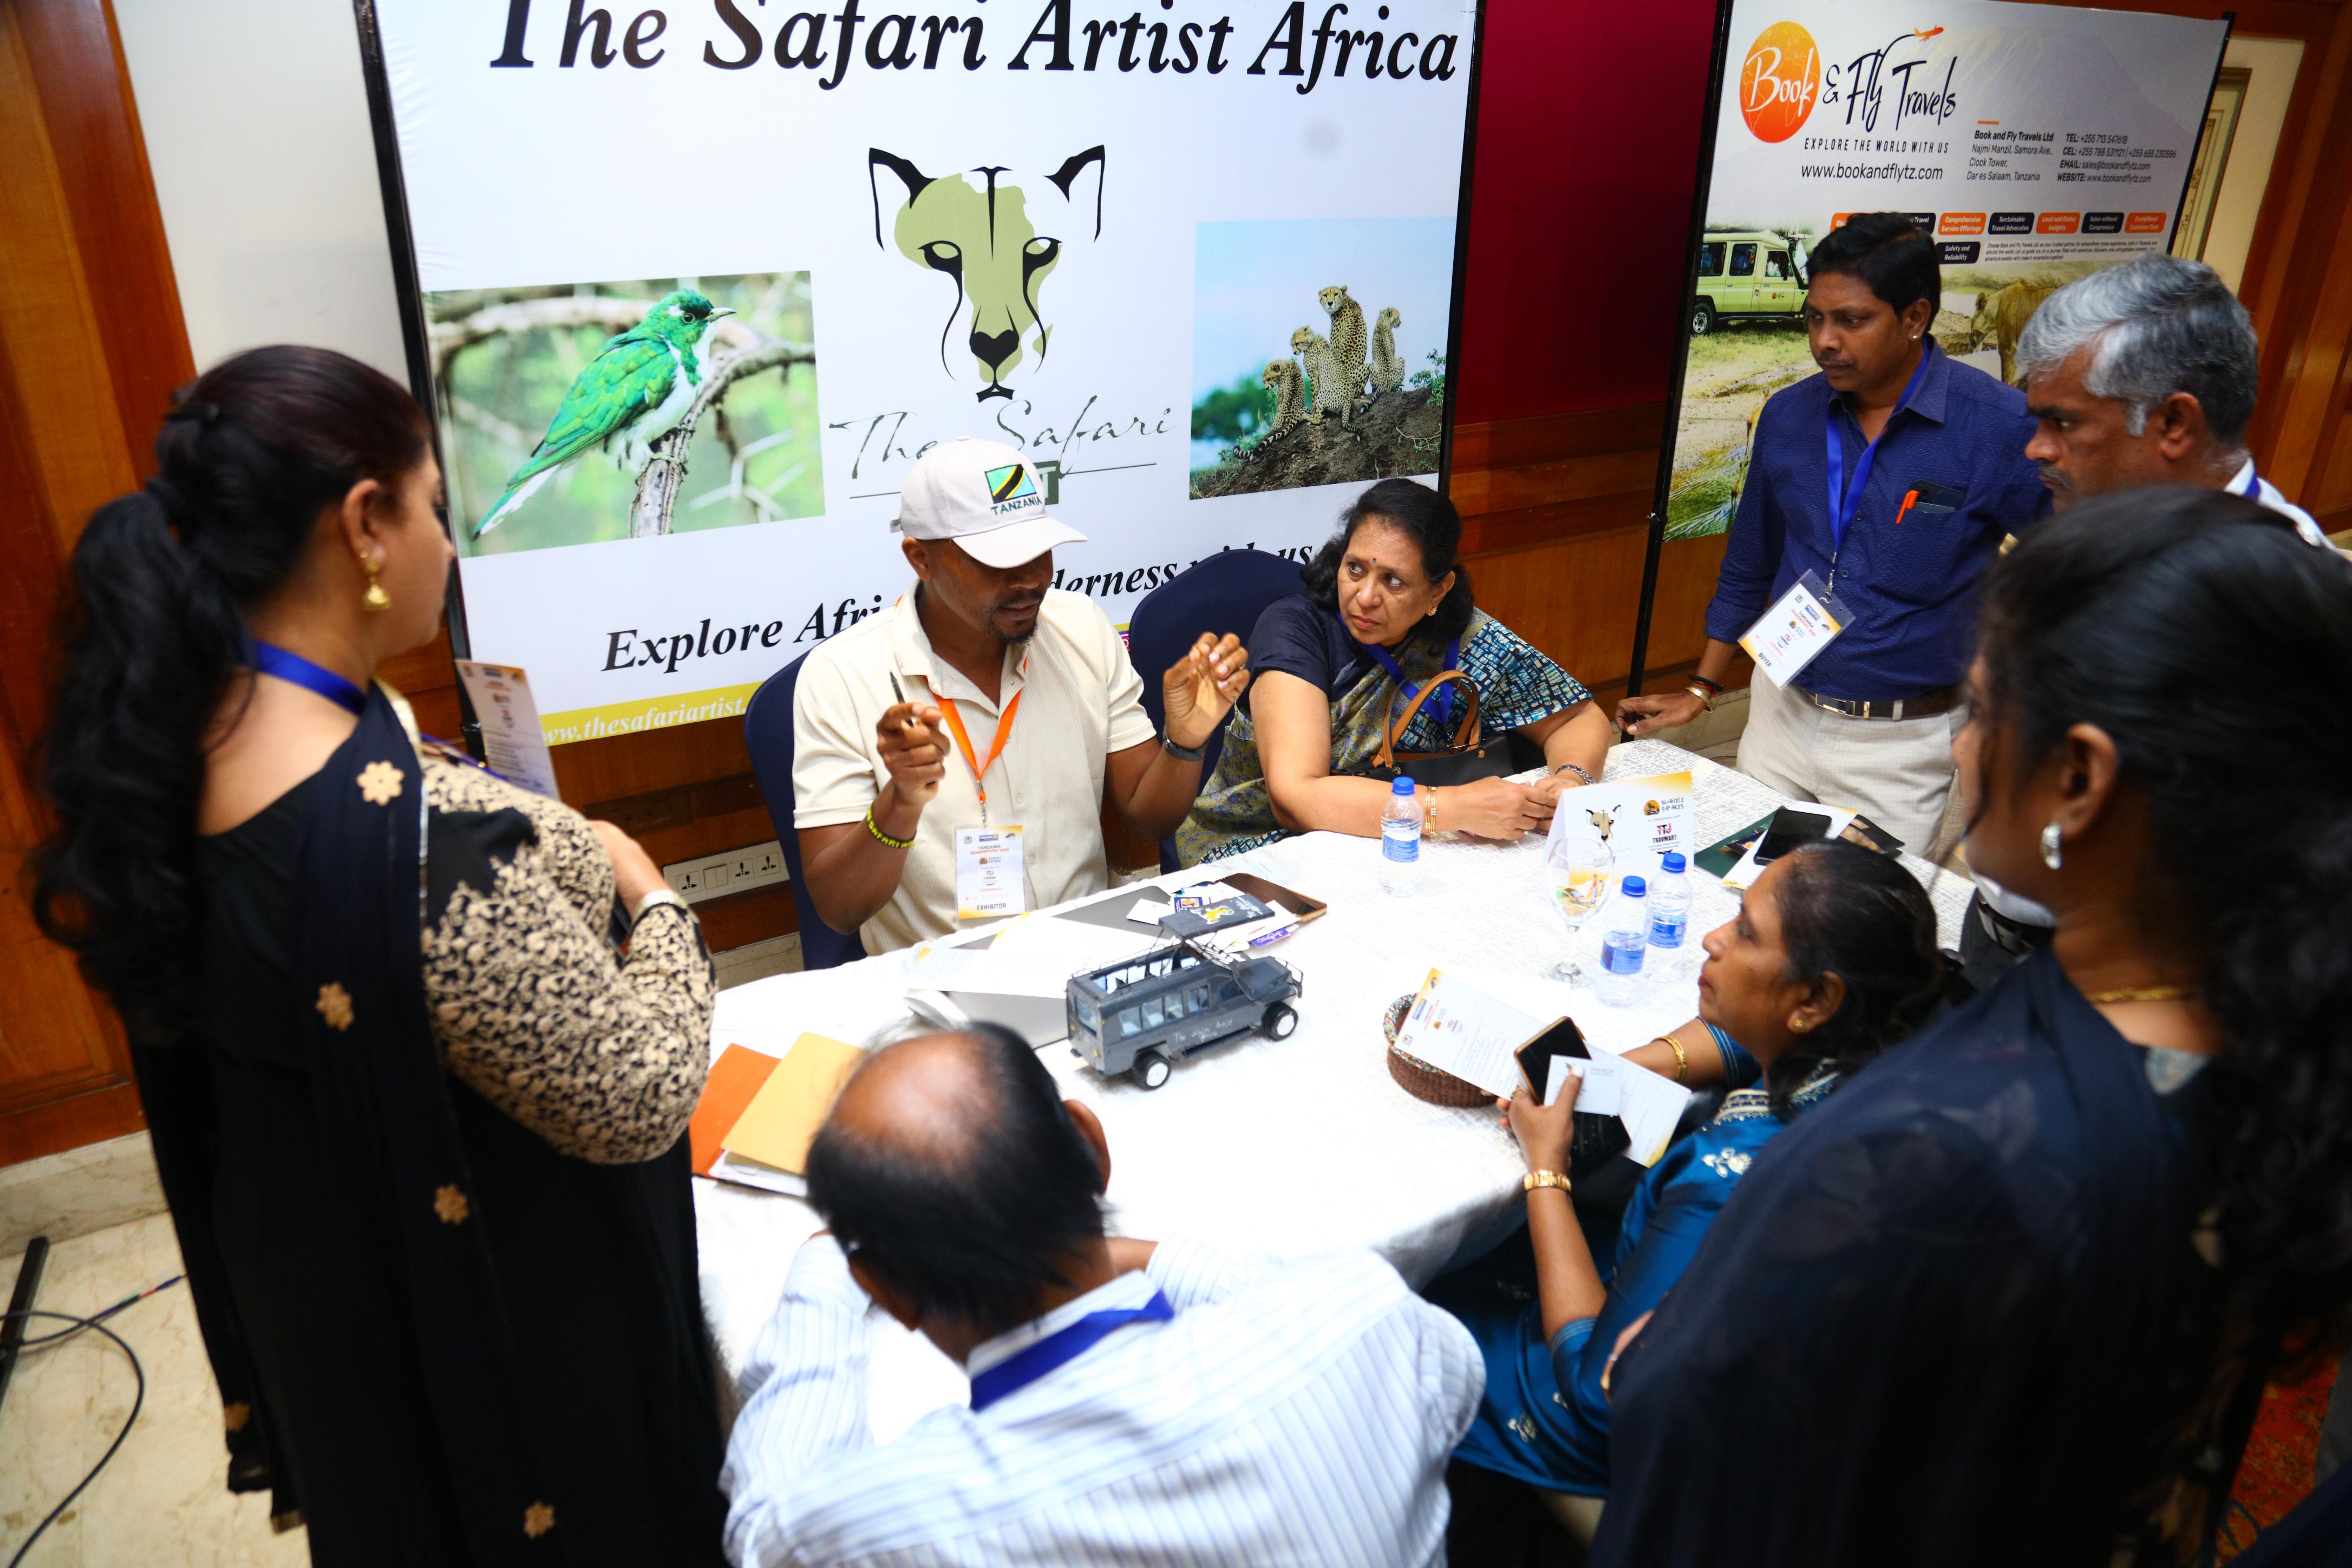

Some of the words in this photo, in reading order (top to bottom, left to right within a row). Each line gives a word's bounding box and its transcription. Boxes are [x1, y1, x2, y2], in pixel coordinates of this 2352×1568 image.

[703, 0, 987, 90] Safari
[1007, 0, 1234, 74] Artist
[1246, 1, 1458, 95] Africa
[1745, 47, 1814, 117] Book
[1822, 64, 1840, 103] &
[1846, 49, 1884, 132] Fly
[1892, 56, 1957, 130] Travels
[1975, 130, 1991, 140] Book
[1992, 132, 2005, 140] and
[2007, 132, 2017, 142] Fly
[2018, 132, 2041, 141] Travels
[2043, 133, 2054, 141] Ltd
[2066, 134, 2079, 142] TEL:
[2081, 134, 2095, 143] +255
[1805, 138, 1849, 151] EXPLORE
[1854, 139, 1870, 151] THE
[1877, 140, 1906, 152] WORLD
[1912, 141, 1933, 153] WITH
[1938, 142, 1949, 153] US
[1971, 145, 1990, 154] Najmi
[1991, 145, 2012, 154] Manzil,
[2014, 145, 2037, 154] Samora
[2063, 147, 2076, 155] CEL:
[2079, 148, 2092, 156] +255
[1969, 158, 1987, 167] Clock
[1989, 158, 2007, 167] Tower,
[2060, 160, 2080, 168] EMAIL:
[1802, 162, 1943, 182] www.bookandflytz.com
[1967, 171, 1978, 180] Dar
[1988, 172, 2011, 181] Salaam,
[2014, 172, 2040, 181] Tanzania
[2057, 173, 2086, 181] WEBSITE:
[2087, 174, 2151, 184] www.bookandflytz.com
[829, 410, 938, 479] The
[996, 395, 1174, 480] Safari
[990, 496, 1042, 516] TANZANIA
[600, 618, 783, 674] Explore
[1048, 563, 1177, 597] derness
[1758, 652, 1772, 667] BUYER
[542, 697, 747, 743] ww.thesafariartist.
[1656, 822, 1672, 835] TTJ
[1652, 834, 1677, 843] TRAVMART
[977, 903, 1006, 911] EXHIBITOR
